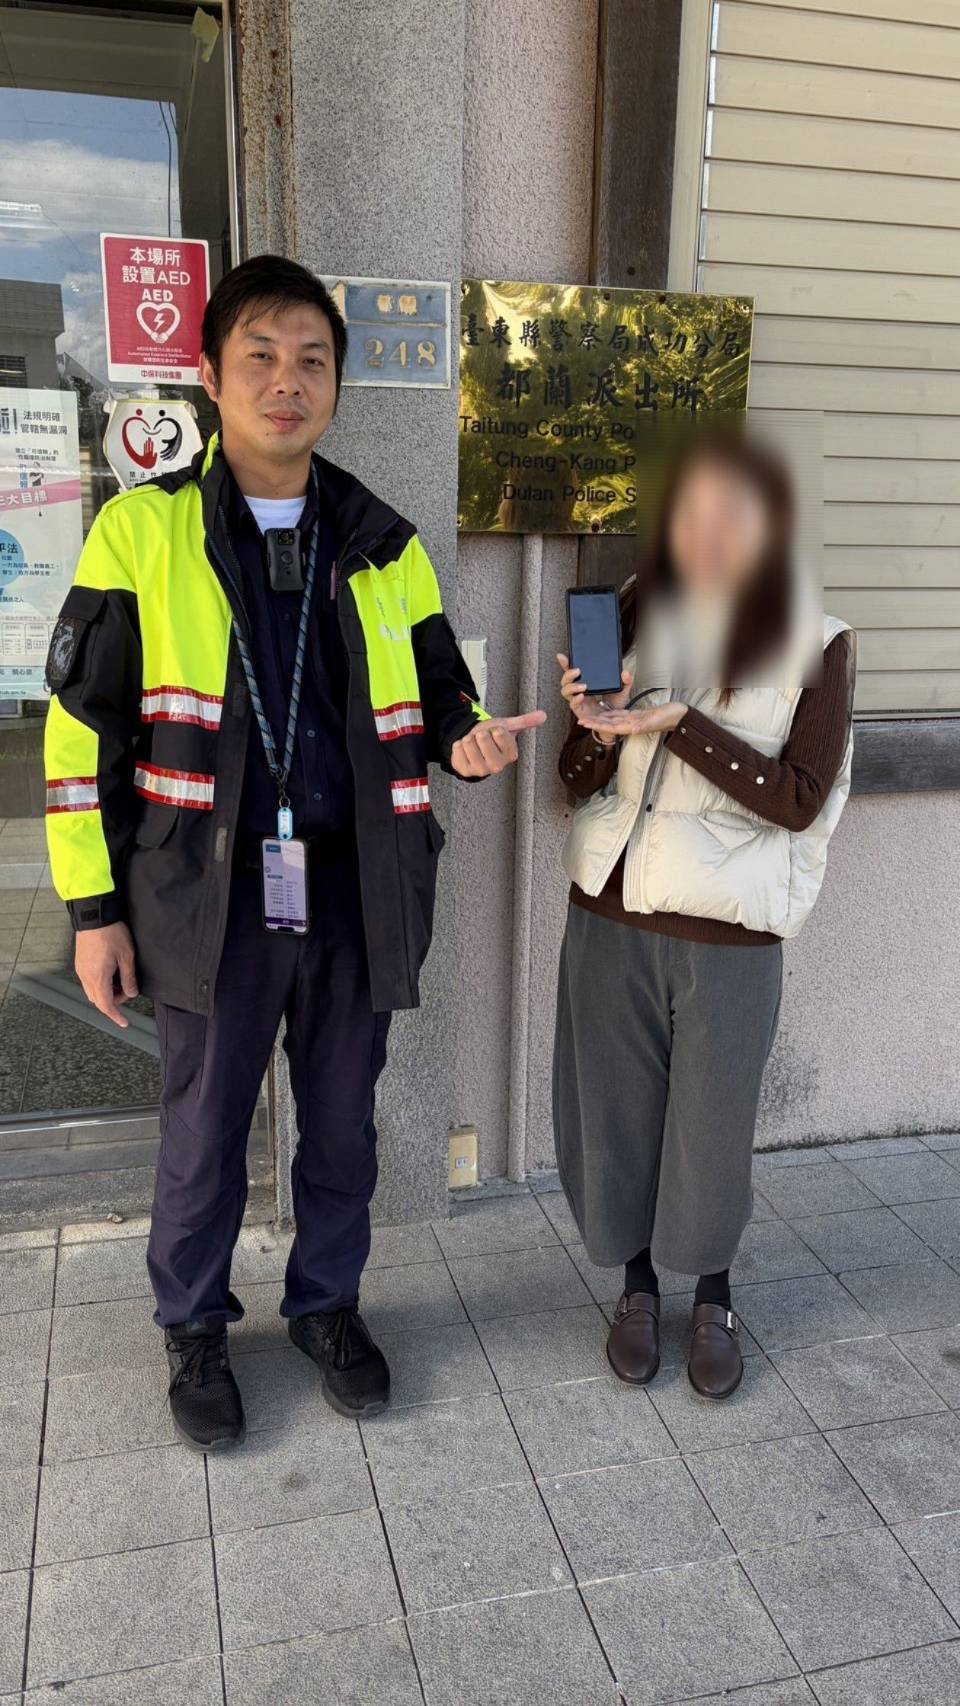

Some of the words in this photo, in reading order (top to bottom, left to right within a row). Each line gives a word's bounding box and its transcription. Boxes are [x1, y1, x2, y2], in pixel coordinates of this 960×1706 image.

[129, 246, 181, 267] 本場所
[121, 265, 191, 285] 設置AED
[142, 288, 174, 302] AED
[462, 314, 741, 357] 臺東縣警察局成功分局
[365, 339, 436, 369] 248
[497, 363, 705, 415] 都蘭派出所
[459, 415, 529, 440] Taitung
[536, 419, 602, 441] County
[495, 451, 617, 474] Cheng-Kang
[502, 483, 553, 501] Dulan
[562, 486, 617, 503] Police
